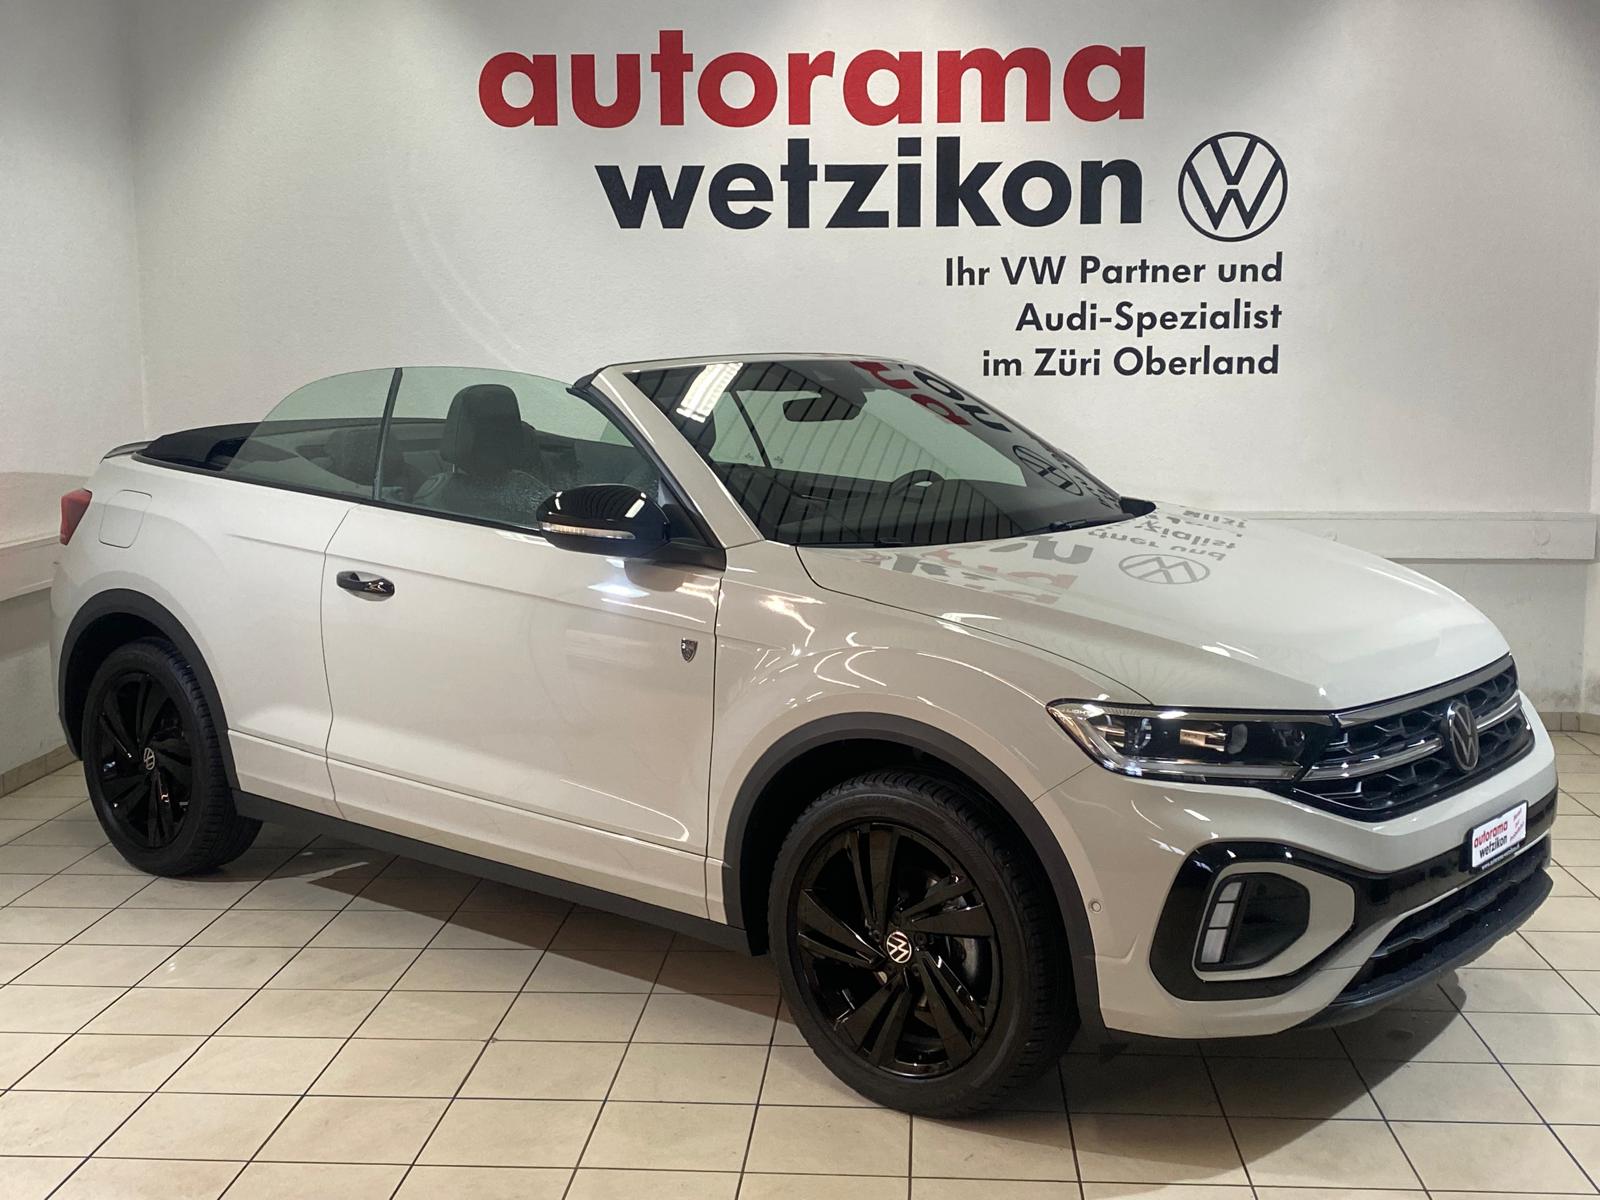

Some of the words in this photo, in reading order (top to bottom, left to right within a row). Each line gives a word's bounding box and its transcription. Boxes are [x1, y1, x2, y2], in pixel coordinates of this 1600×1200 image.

[479, 30, 1145, 128] autorama
[595, 136, 1143, 229] wetzikon
[946, 256, 990, 286] Ihr
[1000, 256, 1067, 285] VW
[1080, 255, 1206, 284] Partner
[1219, 252, 1283, 283] und
[1015, 298, 1283, 337] Audi-Spezialist
[983, 349, 1022, 377] im
[1033, 347, 1101, 377] Züri
[1113, 345, 1279, 376] Oberland
[1474, 821, 1508, 848] autorama
[1480, 835, 1507, 858] wetzikon
